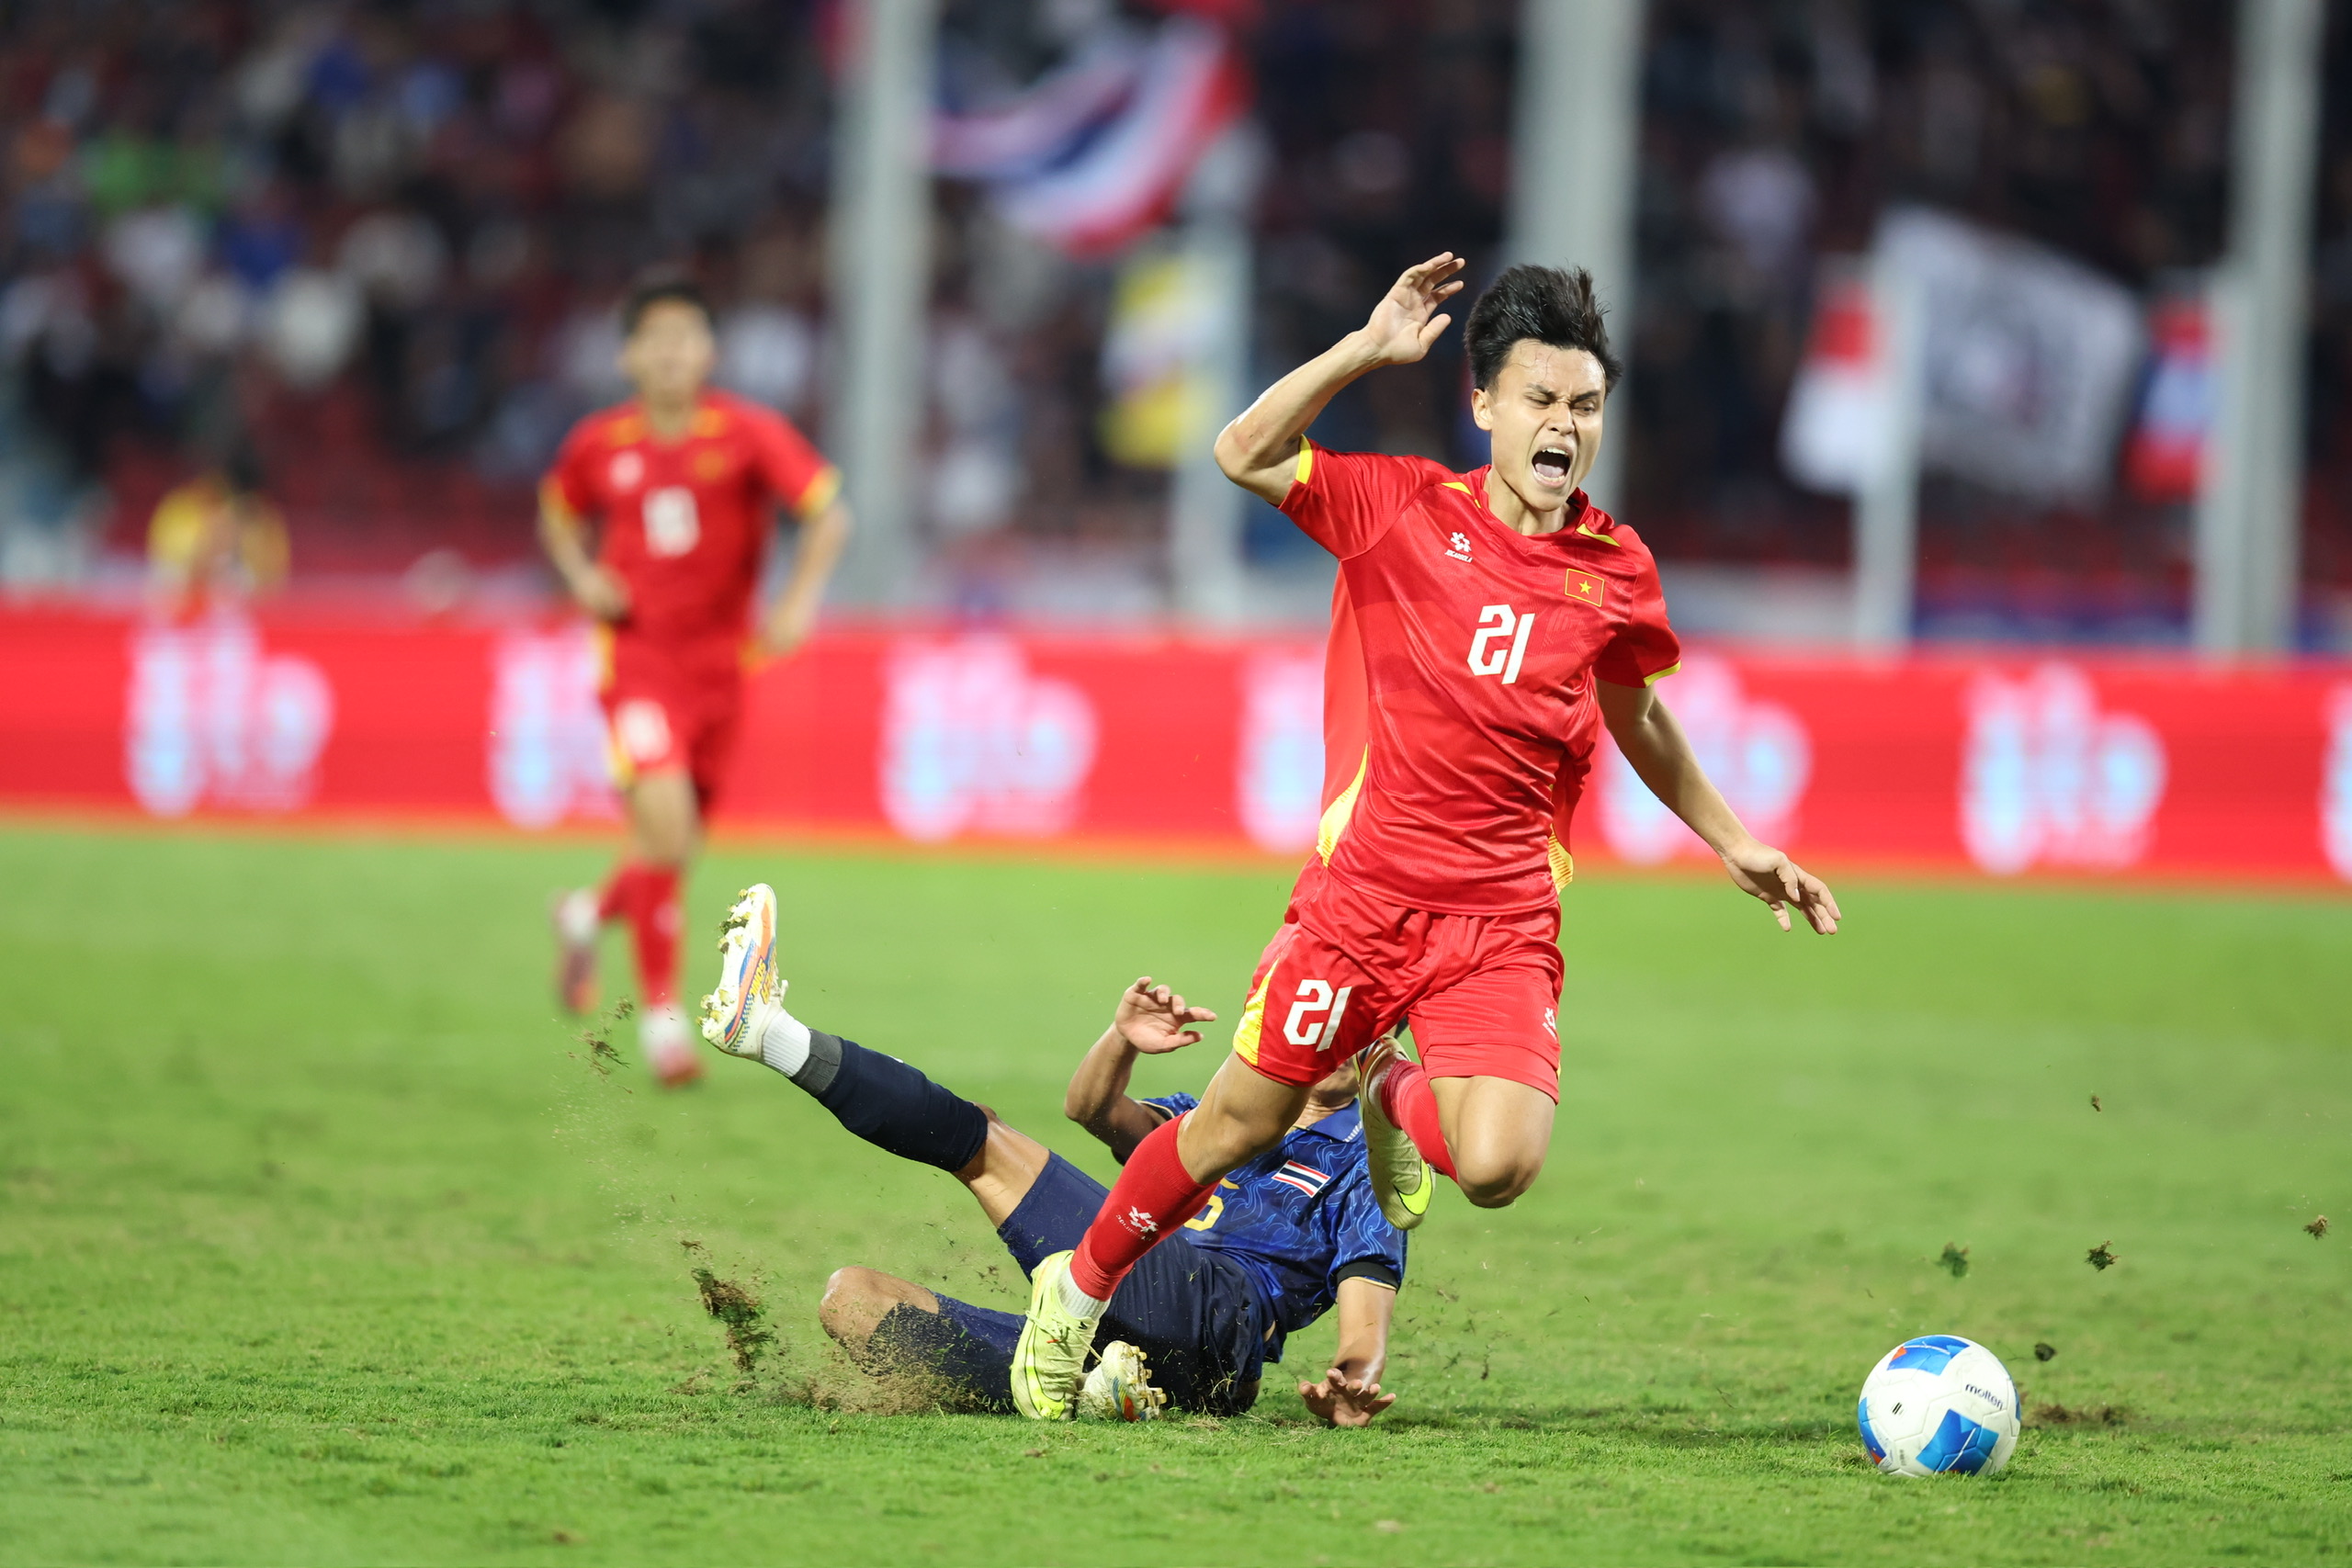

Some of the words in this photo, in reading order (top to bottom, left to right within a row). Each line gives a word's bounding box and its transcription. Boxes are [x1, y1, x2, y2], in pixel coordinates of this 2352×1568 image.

[1467, 604, 1535, 684] 21
[1283, 979, 1352, 1053] 21
[1965, 1383, 2004, 1411] molten
